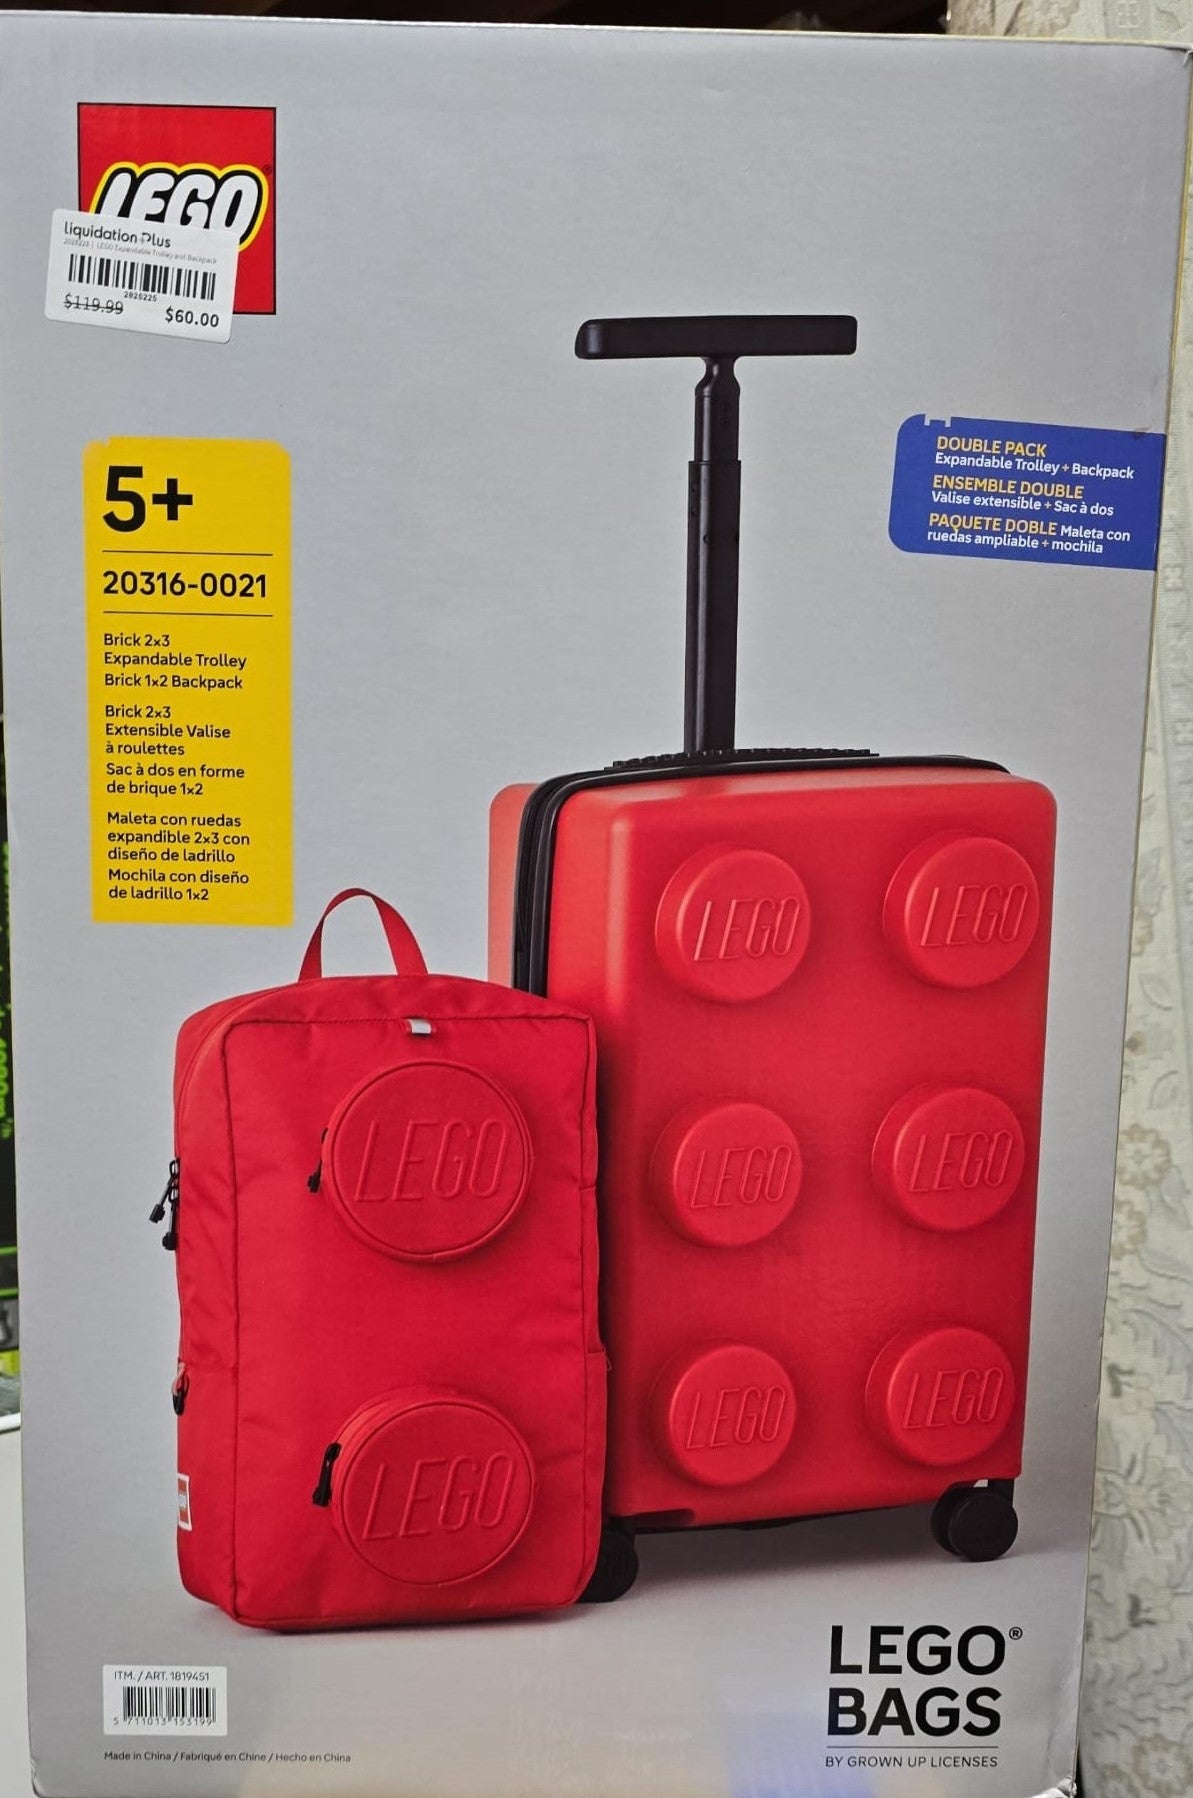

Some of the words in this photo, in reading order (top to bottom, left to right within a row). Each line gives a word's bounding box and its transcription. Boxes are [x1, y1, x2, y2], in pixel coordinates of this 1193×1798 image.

[64, 221, 138, 244] liquidation
[140, 233, 171, 248] Plus
[64, 292, 124, 314] $119.99
[165, 306, 219, 328] $60.00
[937, 436, 1001, 454] DOUBLE
[1005, 443, 1047, 458] PACK
[935, 452, 1012, 470] Expandable
[1015, 458, 1060, 476] Trolley
[1062, 464, 1070, 472] +
[1071, 463, 1135, 480] Backpack
[933, 475, 1017, 493] ENSEMBLE
[1020, 483, 1084, 499] DOUBLE
[102, 466, 193, 532] 5+
[932, 491, 970, 505] Valise
[973, 494, 1042, 510] extensible
[1054, 500, 1077, 513] Sac
[1079, 501, 1088, 514] à
[1090, 503, 1114, 516] dos
[929, 513, 1001, 533] PAQUETE
[1004, 519, 1057, 536] DOBLE
[1060, 525, 1103, 540] Maleta
[1106, 529, 1131, 541] con
[927, 531, 972, 544] ruedas
[974, 533, 1039, 549] ampliable
[1042, 539, 1049, 547] +
[1051, 538, 1103, 553] mochila
[102, 571, 267, 598] 20316-0021
[103, 633, 140, 647] Brick
[145, 634, 170, 647] 2x3
[104, 652, 193, 668] Expandable
[196, 653, 247, 670] Trolley
[105, 674, 141, 687] Brick
[146, 674, 168, 687] 1x2
[172, 675, 243, 691] Backpack
[105, 705, 142, 718] Brick
[145, 706, 171, 718] 2x3
[105, 723, 183, 737] Extensible
[186, 725, 231, 738] Valise
[106, 741, 114, 753] à
[117, 741, 185, 755] roulettes
[106, 763, 132, 775] Sac
[136, 762, 144, 776] à
[148, 763, 175, 777] dos
[178, 767, 196, 777] en
[200, 764, 245, 778] forme
[107, 781, 125, 793] de
[129, 782, 177, 797] brique
[180, 783, 203, 795] 1x2
[107, 812, 157, 825] Maleta
[160, 815, 187, 826] con
[191, 814, 241, 827] ruedas
[107, 831, 191, 845] expandible
[194, 832, 219, 844] 2x3
[223, 834, 250, 845] con
[108, 847, 157, 861] diseño
[161, 848, 179, 861] de
[183, 849, 235, 863] ladrillo
[108, 868, 166, 882] Mochila
[169, 872, 196, 883] con
[200, 870, 250, 884] diseño
[109, 886, 127, 899] de
[131, 887, 183, 900] ladrillo
[186, 888, 209, 901] 1x2
[921, 883, 1028, 948] LEGO
[694, 896, 800, 961] LEGO
[354, 1119, 508, 1202] LEGO
[908, 1129, 1013, 1193] LEGO
[690, 1145, 792, 1209] LEGO
[902, 1367, 1004, 1431] LEGO
[685, 1384, 786, 1450] LEGO
[362, 1452, 514, 1542] LEGO
[114, 1671, 136, 1681] ITM.
[145, 1671, 168, 1681] ART.
[170, 1671, 210, 1682] 1819451
[827, 1686, 1002, 1737] BAGS
[104, 1752, 131, 1761] Made
[133, 1752, 142, 1761] in
[144, 1752, 171, 1761] China
[180, 1752, 222, 1763] Fabriqué
[239, 1752, 266, 1762] Chine
[275, 1753, 307, 1762] Hecho
[323, 1753, 351, 1762] China
[825, 1756, 843, 1767] BY
[847, 1756, 902, 1767] GROWN
[907, 1756, 926, 1767] UP
[930, 1756, 998, 1767] LICENSES
